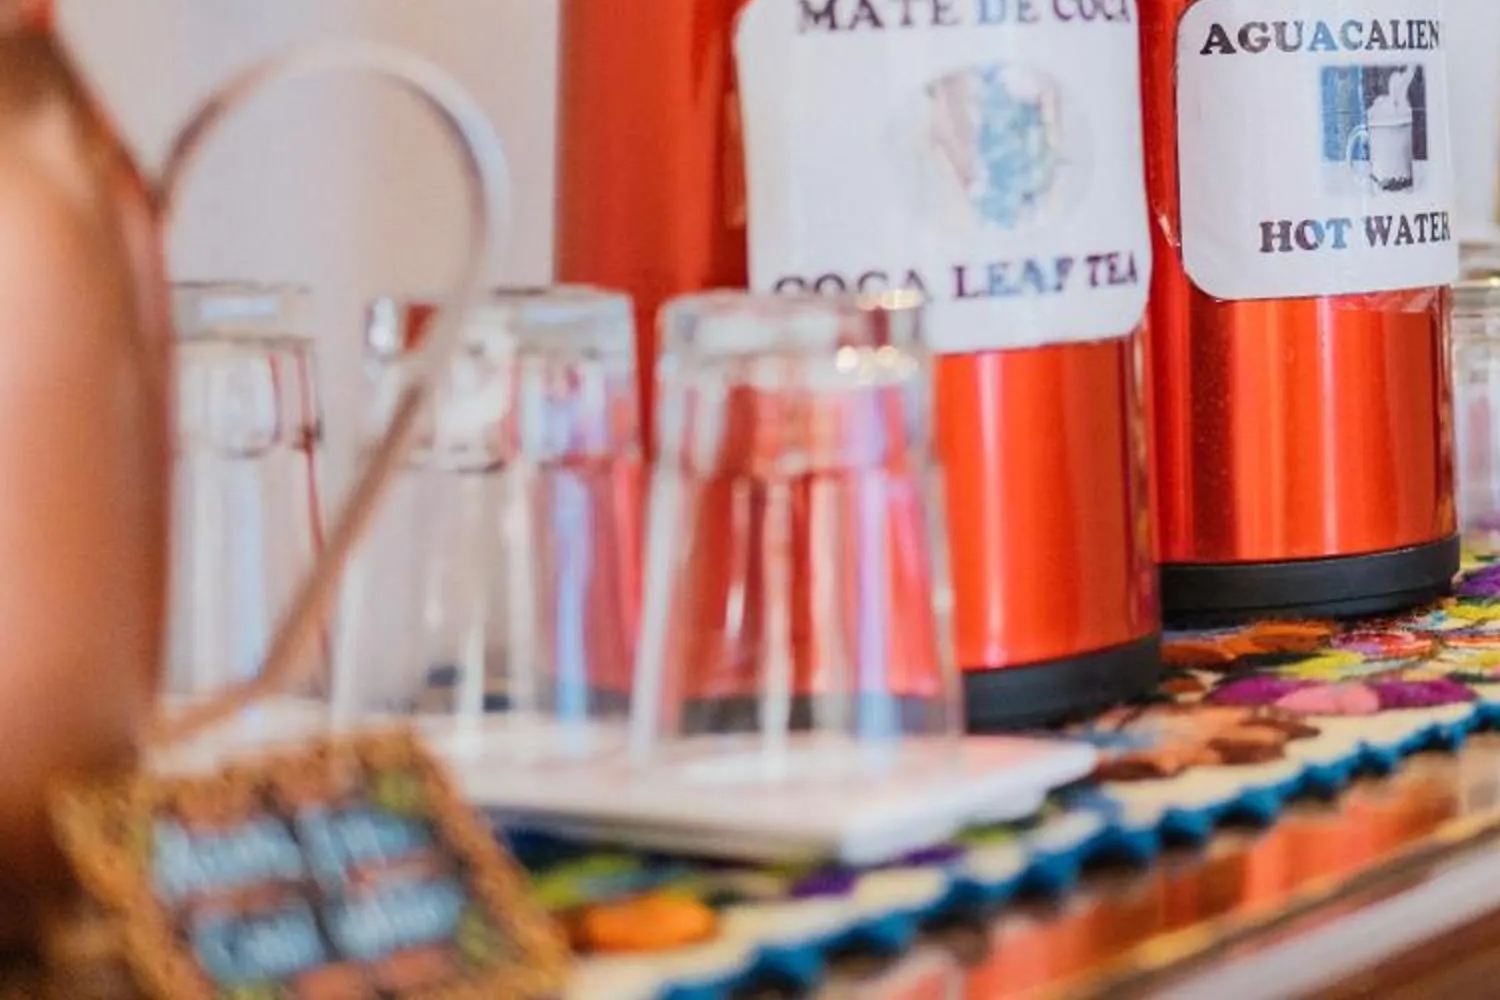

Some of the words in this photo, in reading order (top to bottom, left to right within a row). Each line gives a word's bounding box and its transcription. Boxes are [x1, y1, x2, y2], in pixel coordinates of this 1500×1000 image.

[1259, 217, 1352, 252] HOT
[1362, 211, 1450, 247] WATER
[952, 256, 1073, 299] LEAF
[1085, 250, 1137, 289] TEA
